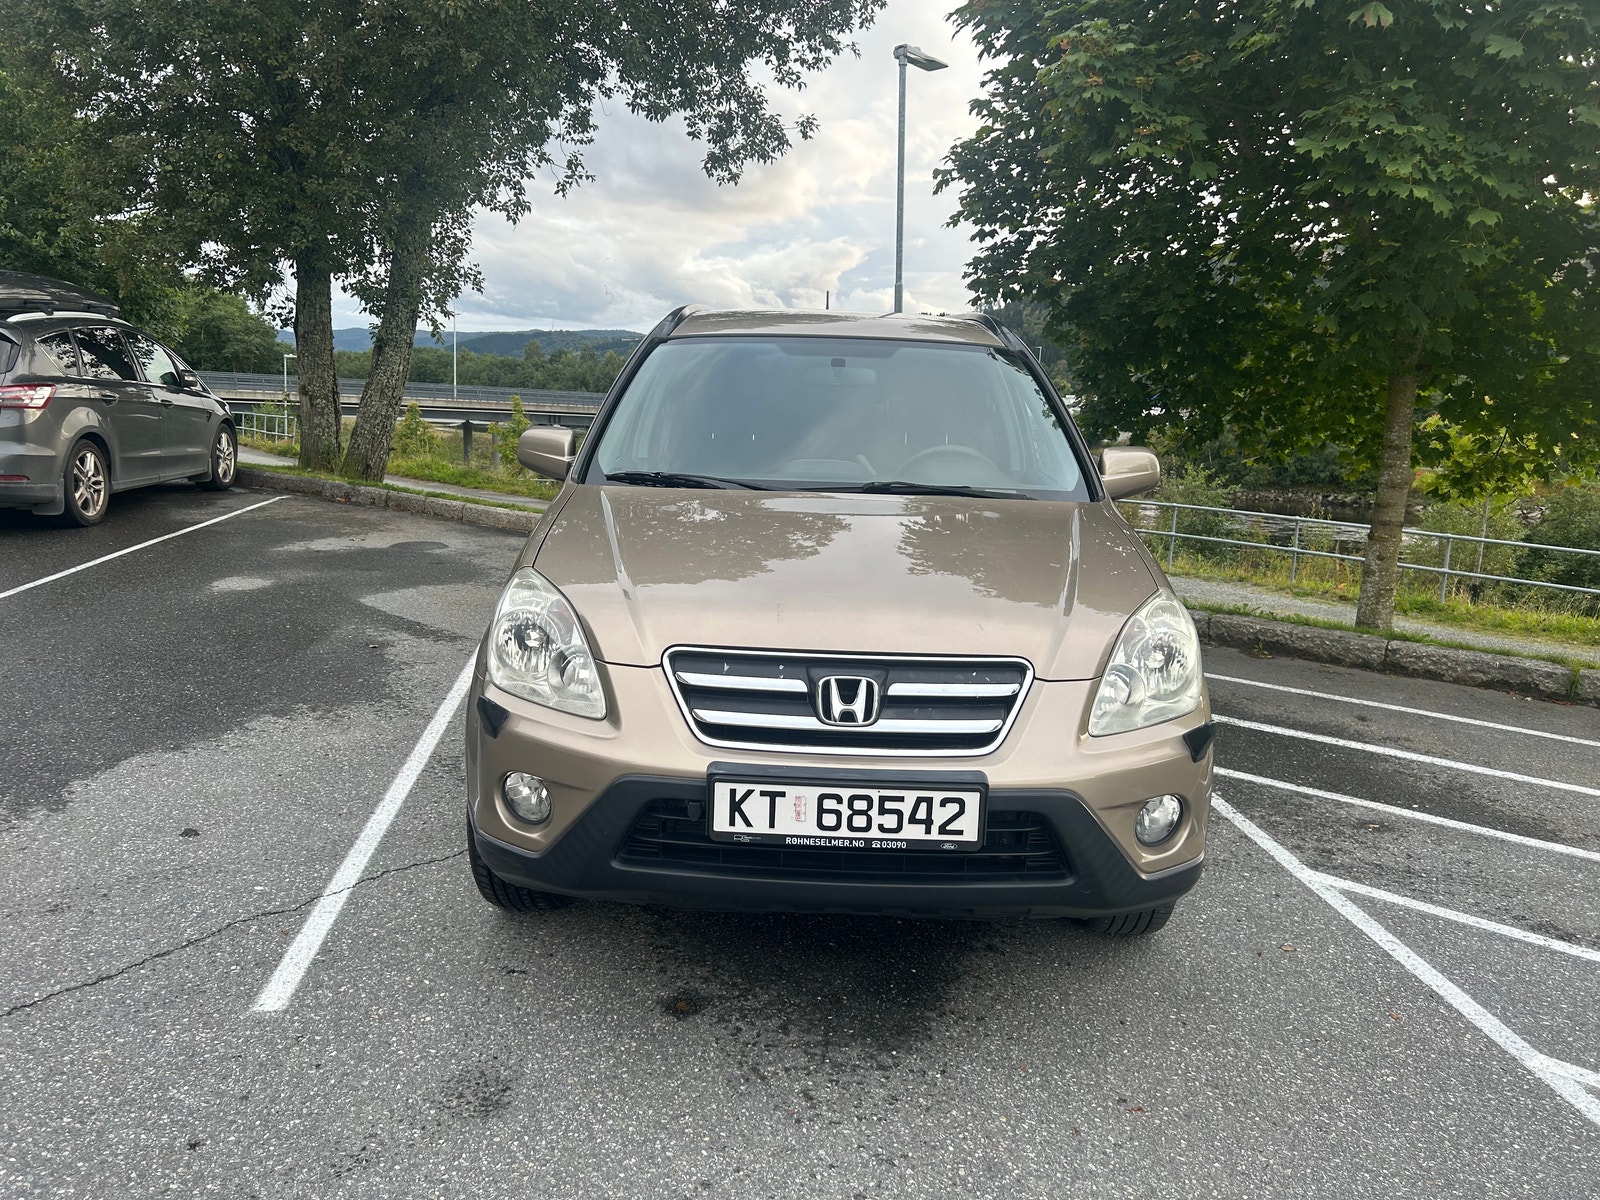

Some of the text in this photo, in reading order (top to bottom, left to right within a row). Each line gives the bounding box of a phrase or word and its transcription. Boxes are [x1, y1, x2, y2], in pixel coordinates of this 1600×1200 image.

[728, 788, 786, 829] KT
[816, 793, 966, 836] 68542
[785, 837, 907, 849] RØHNESELMER.NO 03090
